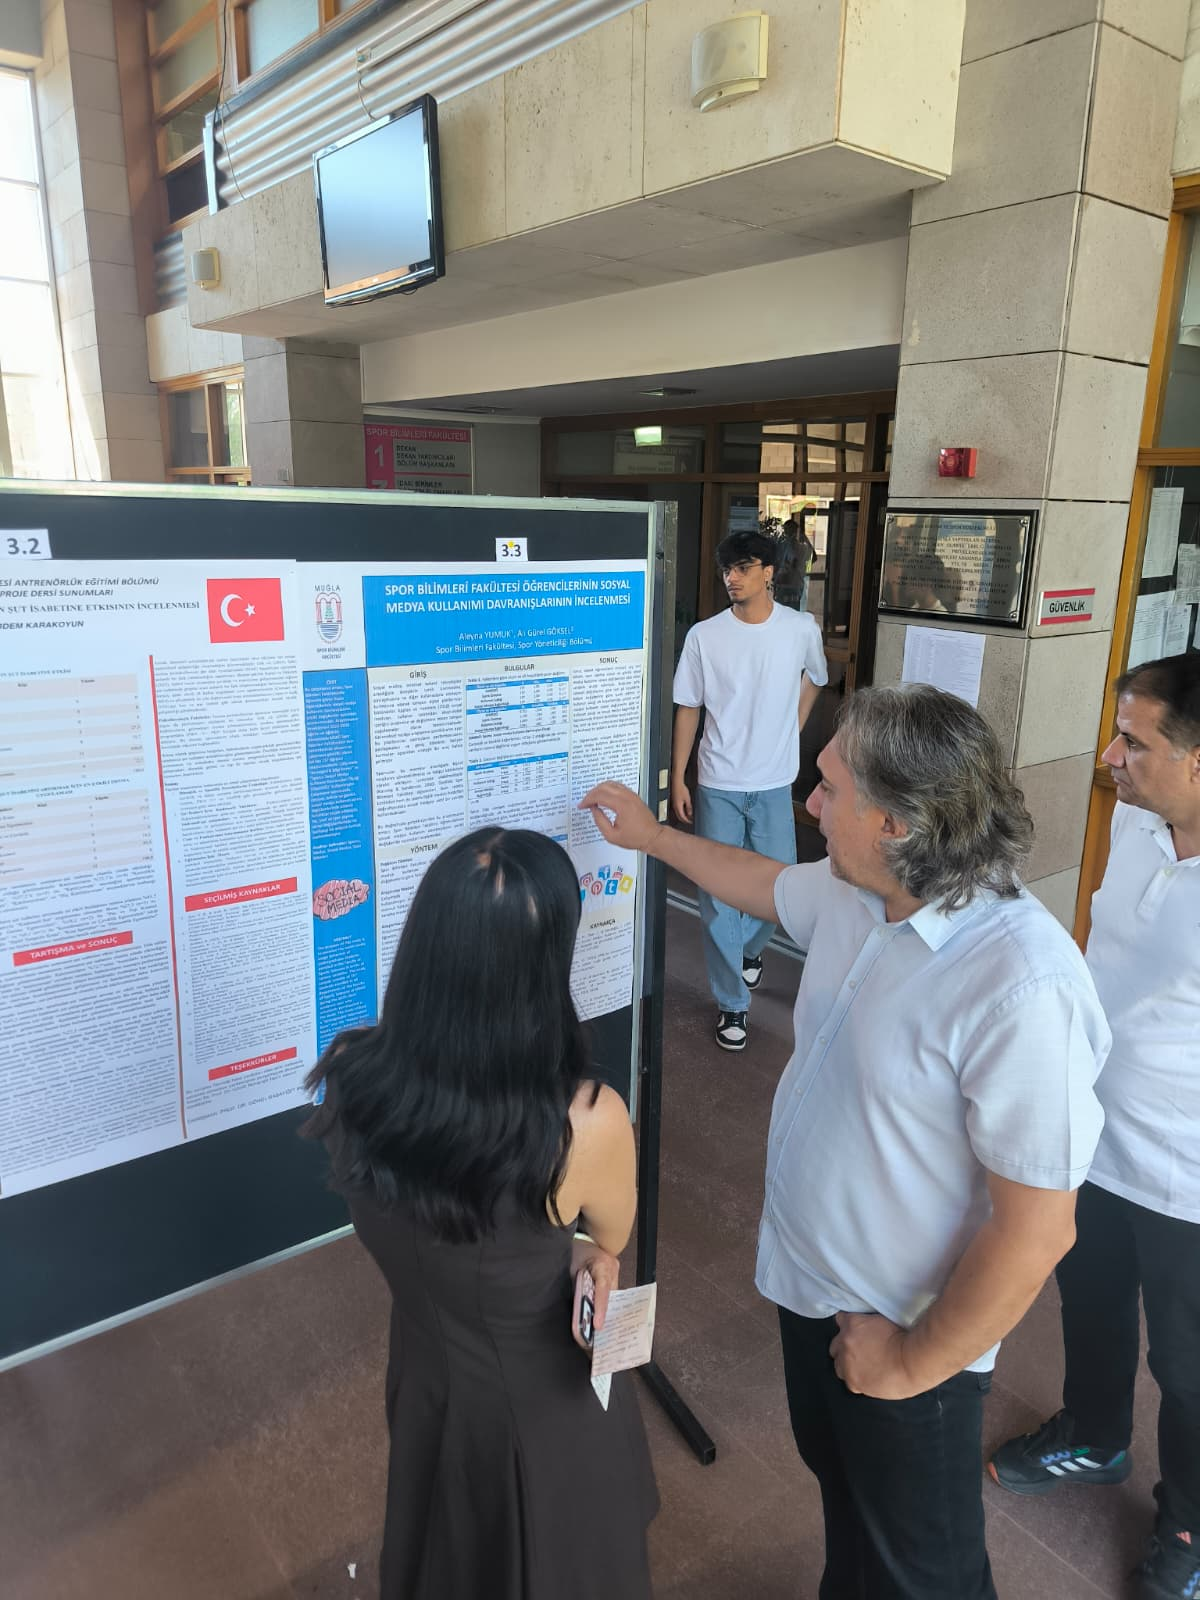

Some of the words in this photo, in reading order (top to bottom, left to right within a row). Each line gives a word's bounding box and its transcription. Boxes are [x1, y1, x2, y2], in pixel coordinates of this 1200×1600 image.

[374, 444, 384, 467] 1
[7, 538, 41, 555] 3.2
[502, 544, 521, 557] 3.3
[14, 578, 82, 587] ANTRENÖRLÜK
[85, 577, 119, 586] EĞİTİMİ
[121, 577, 159, 585] BÖLÜMÜ
[386, 584, 414, 596] SPOR
[418, 581, 468, 595] BİLİMLERİ
[471, 580, 521, 593] FAKÜLTESİ
[523, 578, 599, 592] ÖĞRENCİLERİNİN
[600, 579, 630, 591] SOSYAL
[30, 588, 57, 597] DERSİ
[59, 589, 114, 597] SUNUMLARI
[386, 601, 425, 613] MEDYA
[428, 599, 484, 612] KULLANIMI
[487, 596, 572, 612] DAVRANIŞLARININ
[574, 593, 630, 607] İNCELENMESİ
[1049, 599, 1085, 613] GÜVENLİK
[26, 620, 84, 629] KARAKOYUN
[409, 670, 427, 679] GİRİŞ
[504, 663, 535, 671] BULGULAR
[410, 843, 438, 854] YÖNTEM
[203, 892, 237, 903] SEÇİLMİŞ
[239, 884, 281, 897] KAYNAKLAR
[317, 882, 362, 907] SOCIAL
[326, 895, 361, 915] MEDIA
[30, 945, 74, 959] TARTIŞMA
[88, 936, 118, 948] SONUÇ
